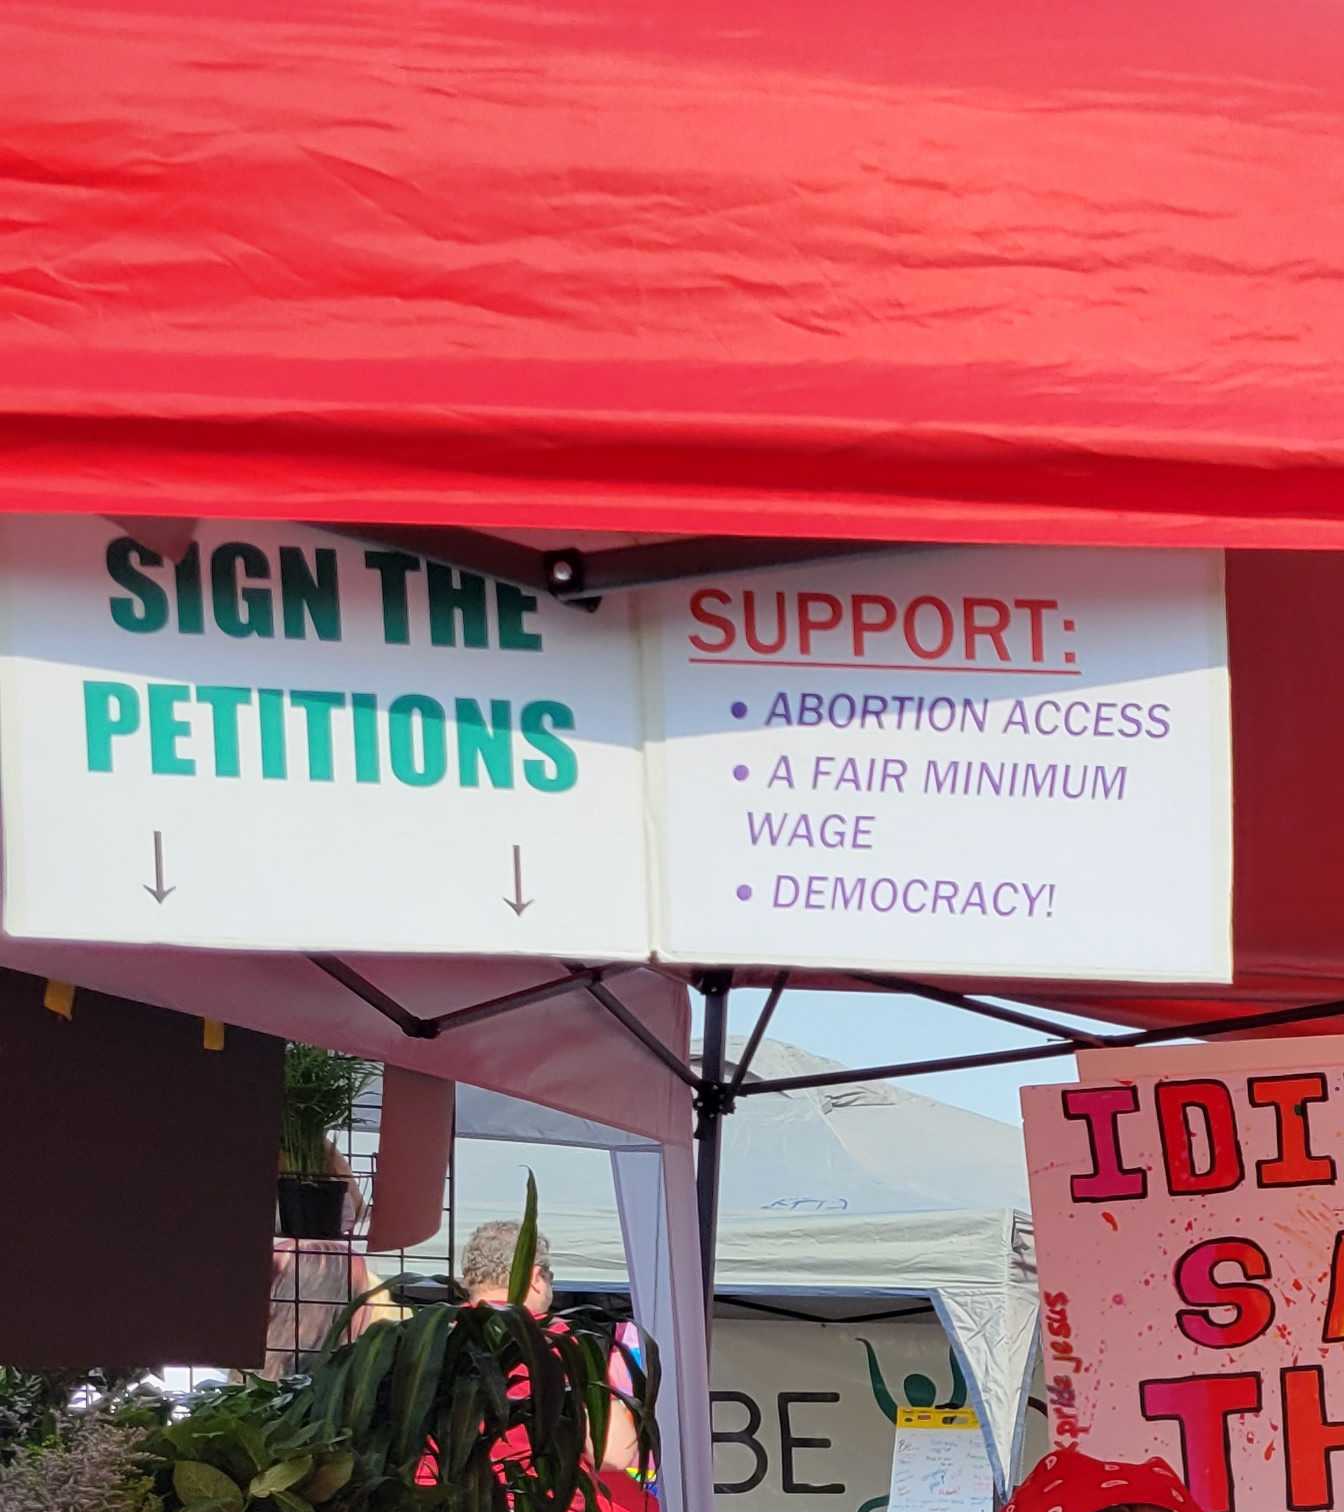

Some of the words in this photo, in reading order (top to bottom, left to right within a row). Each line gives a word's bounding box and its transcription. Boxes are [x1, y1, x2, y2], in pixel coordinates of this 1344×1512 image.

[105, 536, 342, 642] SIGN
[364, 548, 544, 652] THE
[688, 587, 1078, 665] SUPPORT:
[82, 680, 578, 793] PETITIONS
[765, 691, 988, 733] ABORTION
[1003, 699, 1172, 739] ACCESS
[767, 755, 795, 789] A
[812, 756, 908, 793] FAIR
[923, 760, 1129, 801] MINIMUM
[746, 811, 876, 849] WAGE
[772, 874, 1056, 918] DEMOCRACY!
